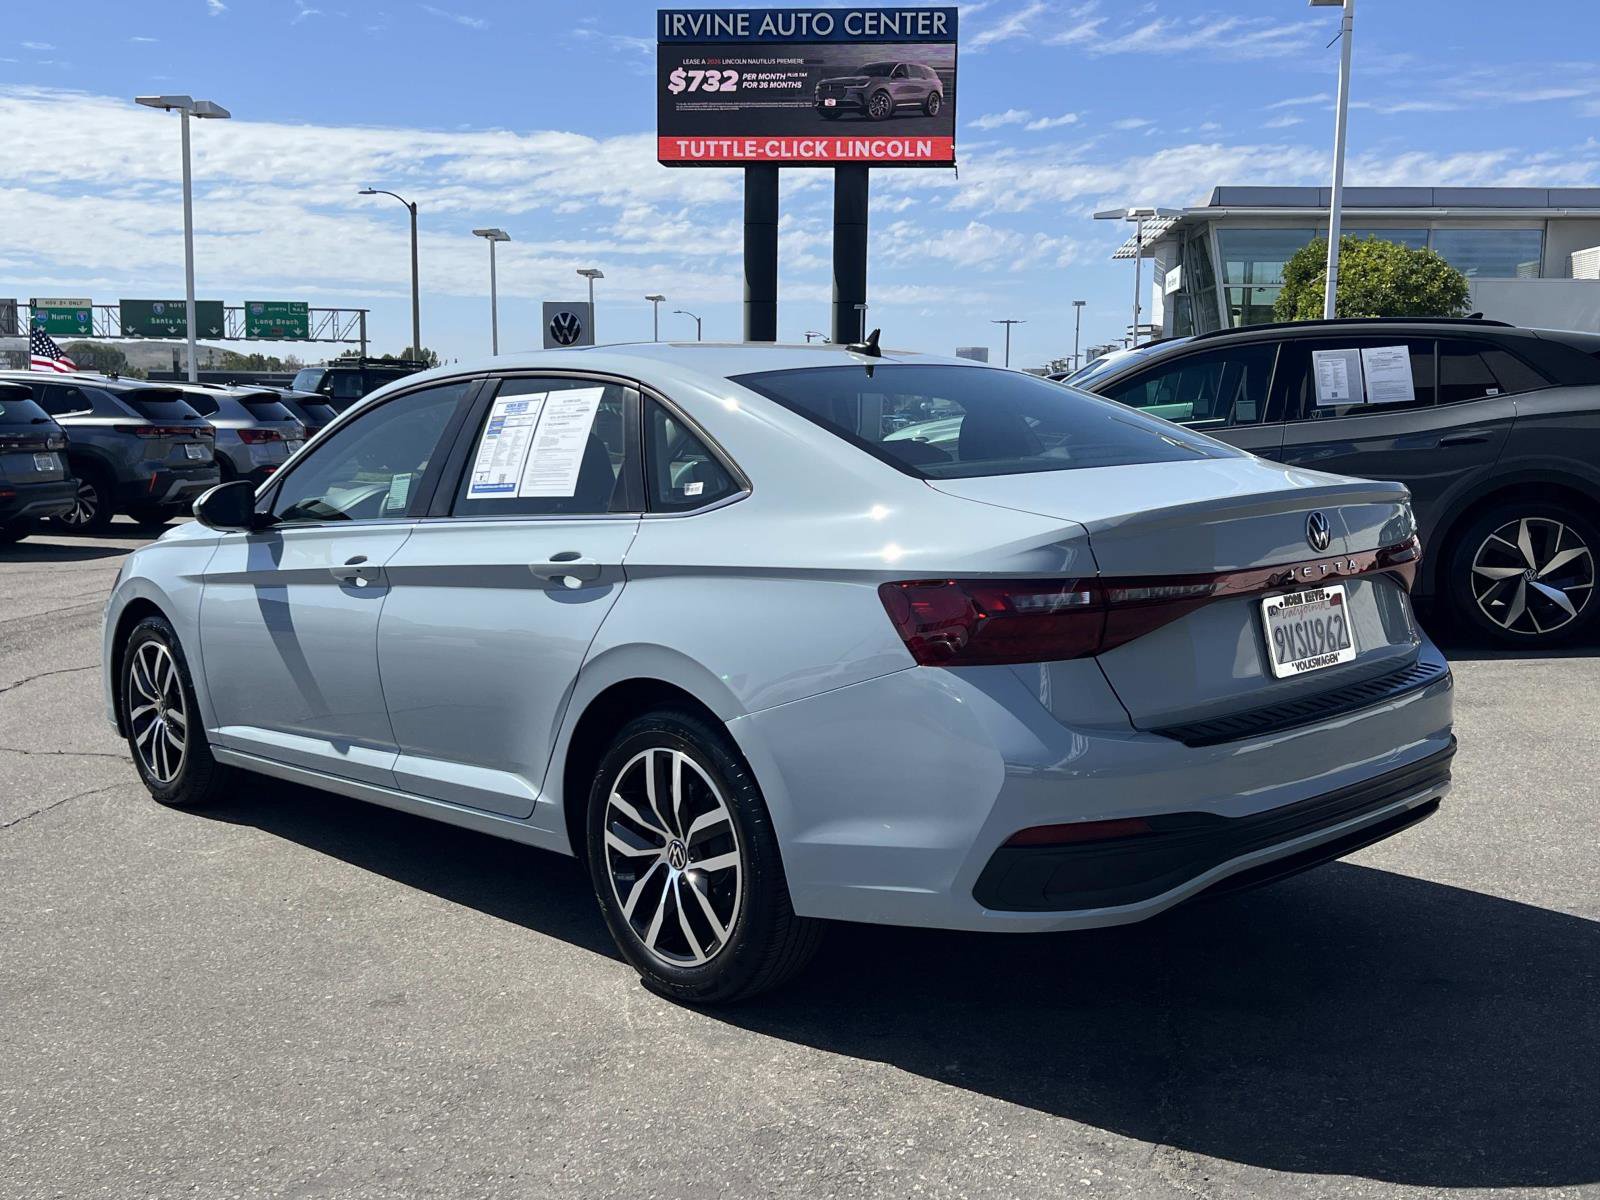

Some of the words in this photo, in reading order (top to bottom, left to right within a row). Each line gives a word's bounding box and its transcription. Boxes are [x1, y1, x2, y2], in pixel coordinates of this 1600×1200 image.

[664, 13, 750, 36] IRVINE
[758, 12, 834, 36] AUTO
[844, 11, 948, 35] CENTER
[667, 67, 739, 95] $732
[742, 73, 757, 81] PER
[758, 73, 786, 81] MONTH
[742, 81, 758, 89] FOR
[759, 81, 769, 89] 36
[769, 81, 802, 89] MONTHS
[676, 140, 829, 158] TUTTLE-CLICK
[835, 140, 932, 158] LINCOLN
[151, 317, 173, 325] Santa
[176, 317, 187, 325] An
[254, 318, 273, 326] Long
[1287, 560, 1356, 580] JETTA
[1274, 614, 1344, 664] 9VSU962
